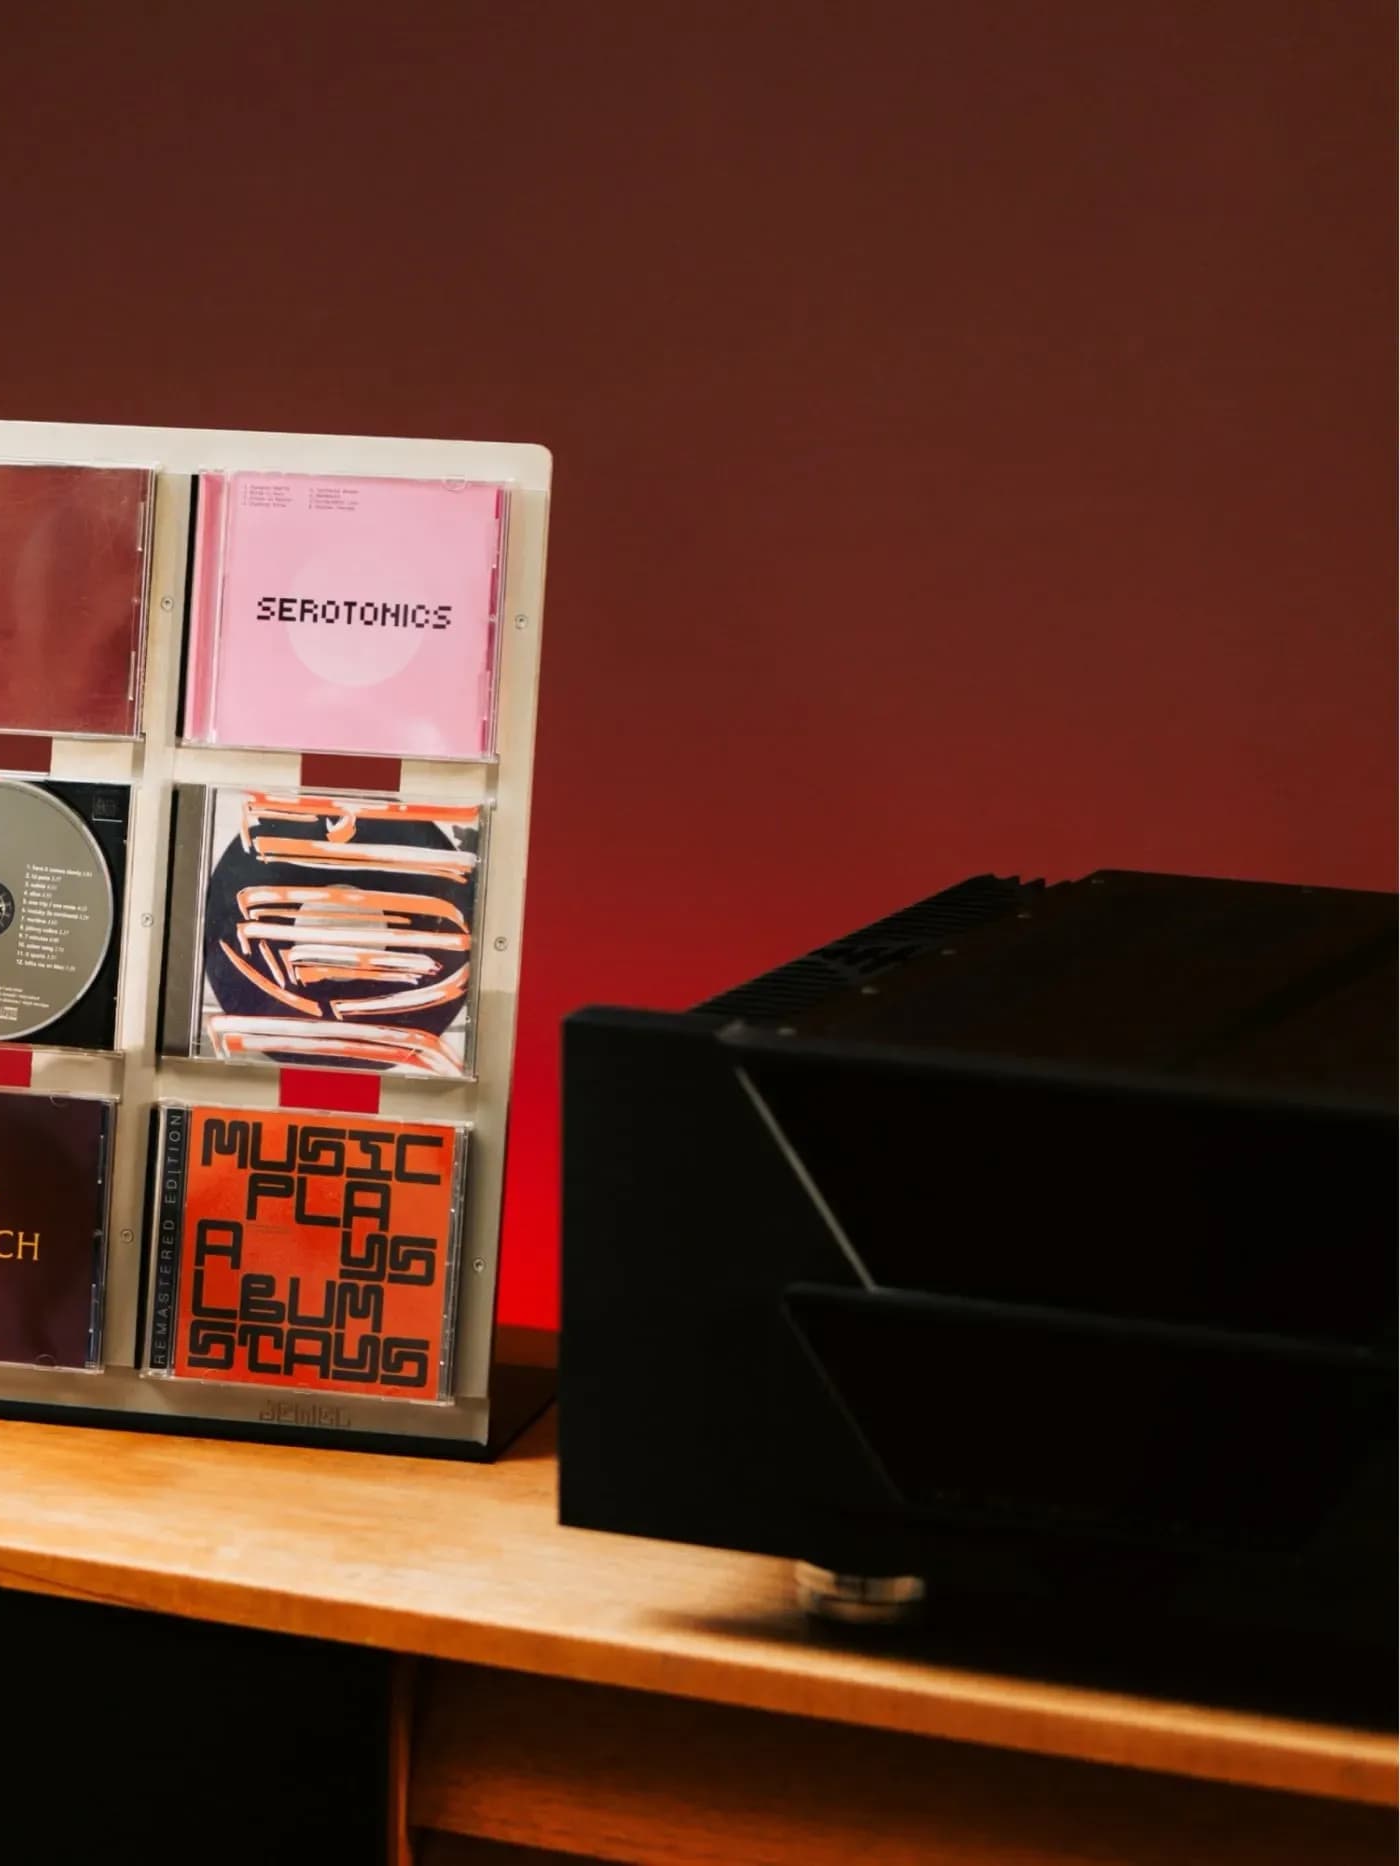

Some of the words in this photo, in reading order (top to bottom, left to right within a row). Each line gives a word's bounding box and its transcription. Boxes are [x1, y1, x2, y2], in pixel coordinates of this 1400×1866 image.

[256, 596, 452, 630] SEROTONICS
[164, 1114, 182, 1204] EDITION
[201, 1118, 443, 1185] MUSIC
[153, 1218, 176, 1365] REMASTERED
[187, 1319, 430, 1388] STAYS
